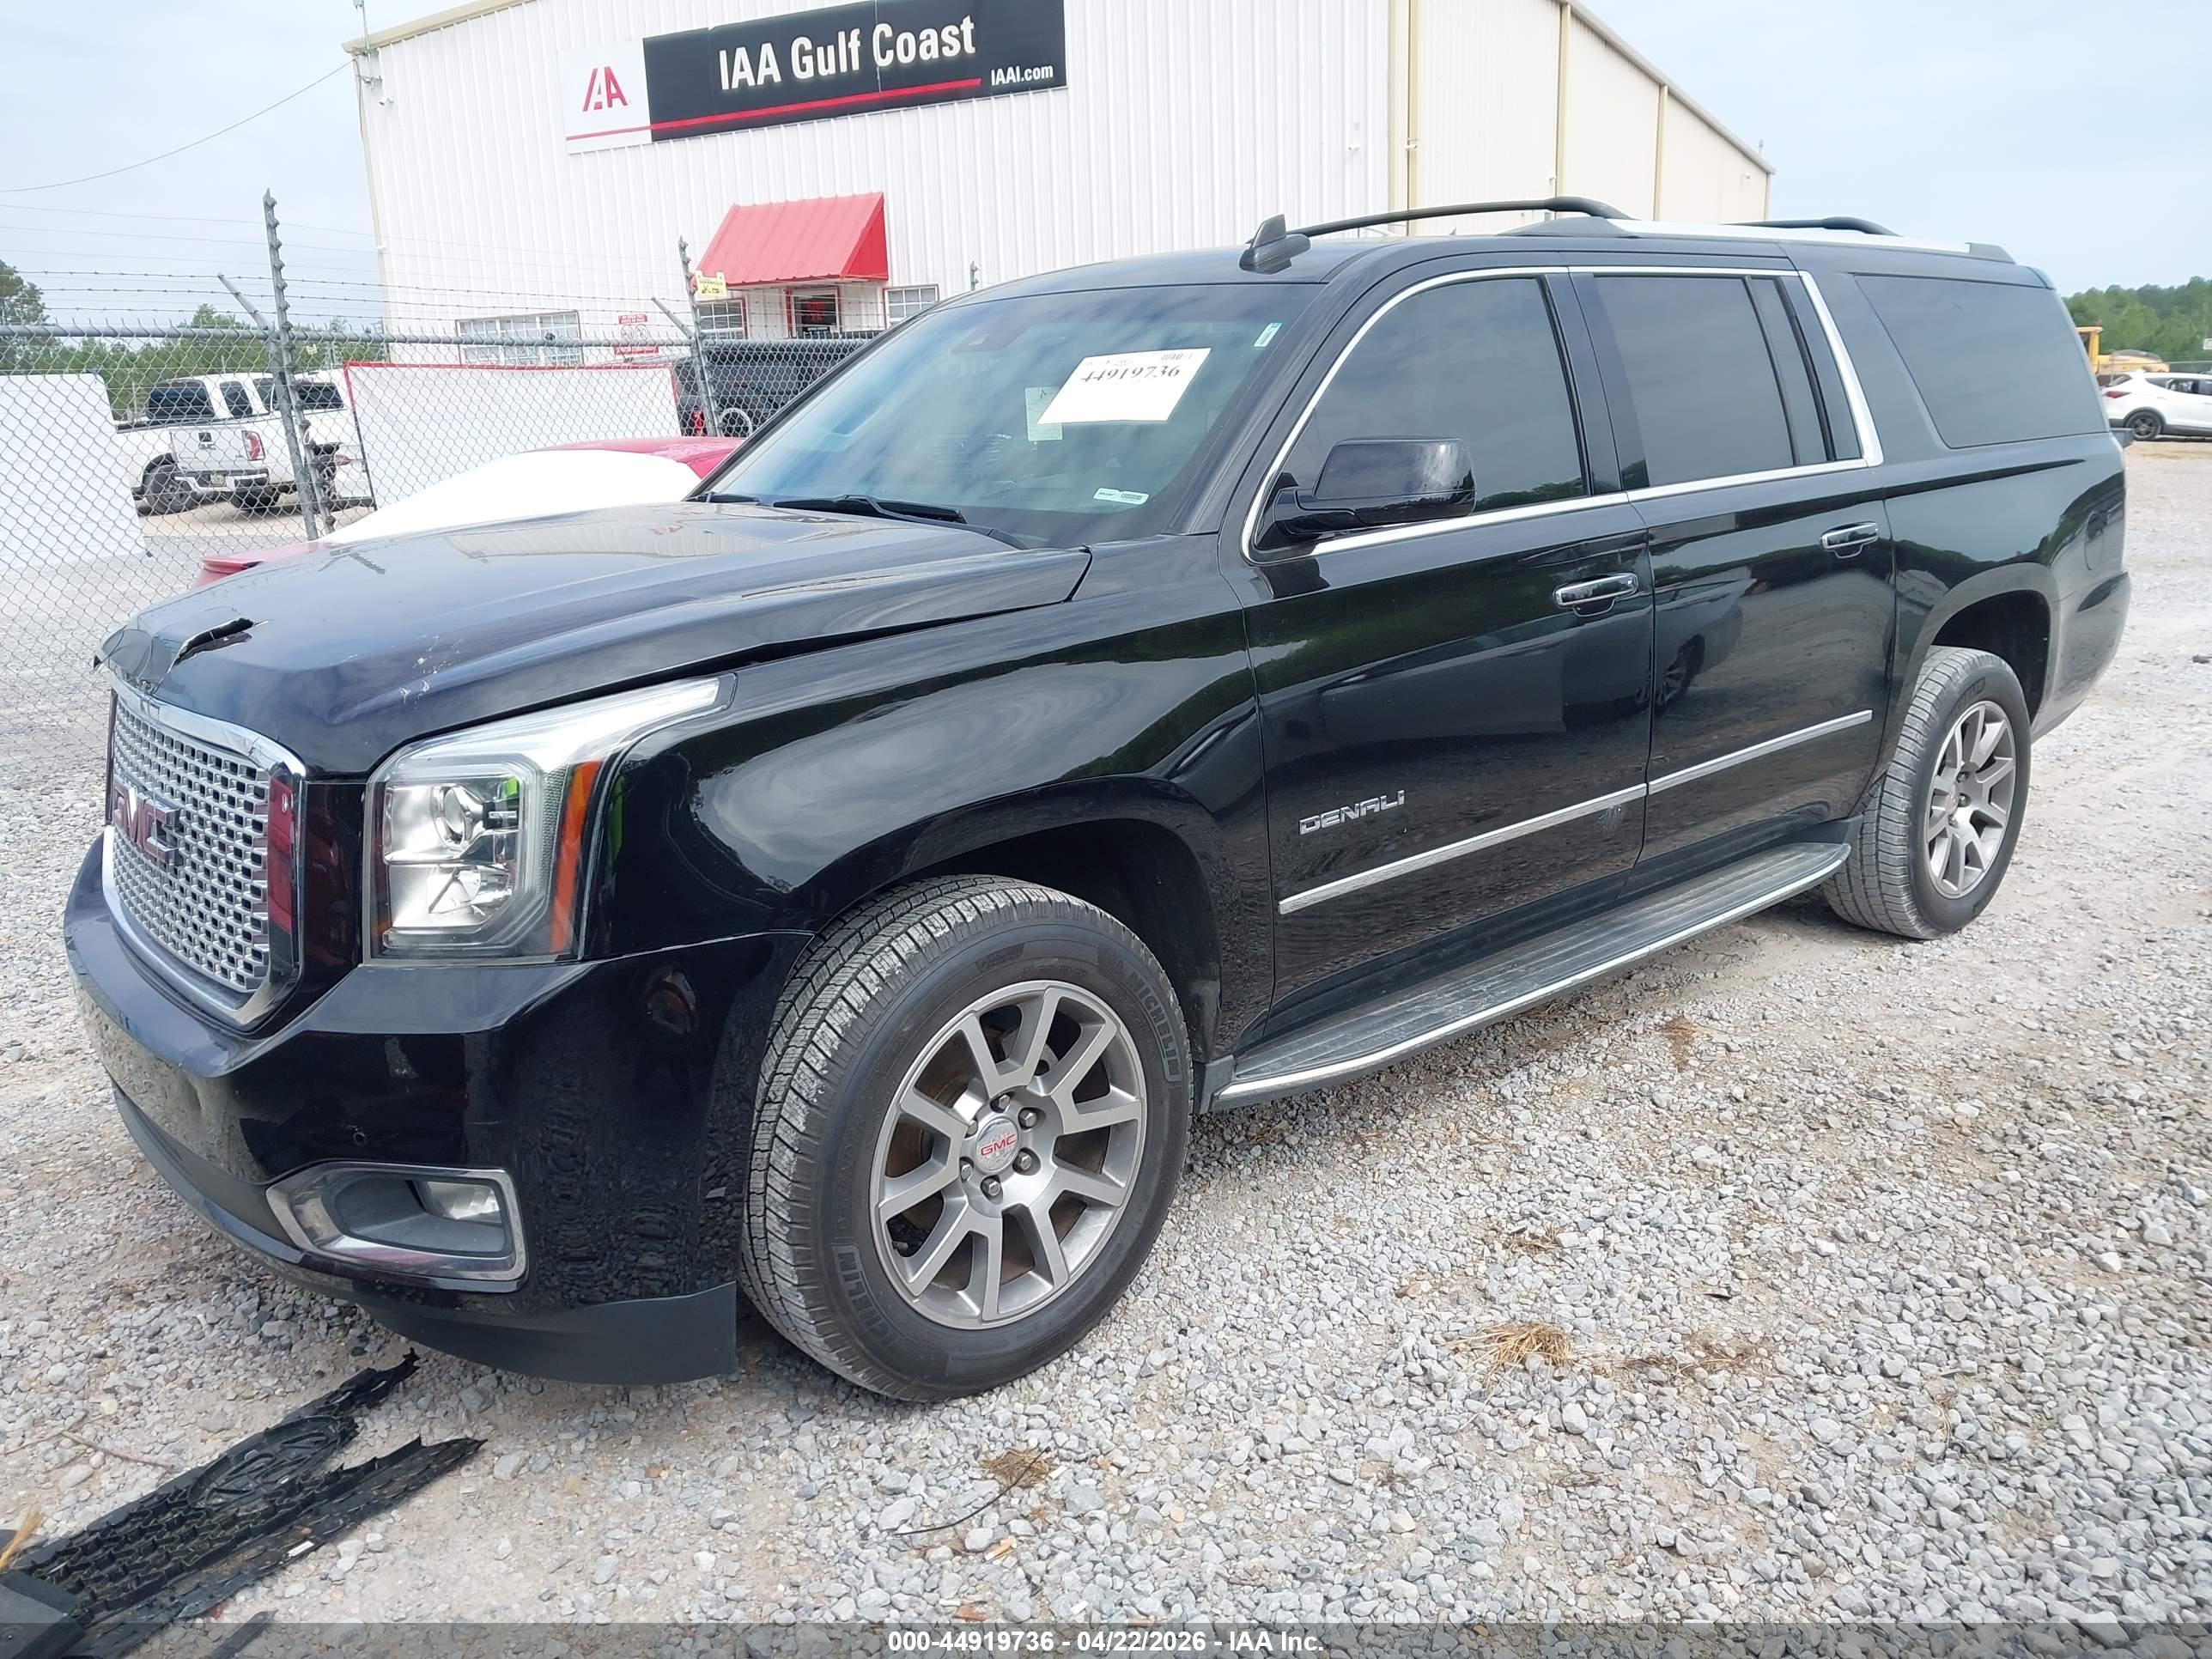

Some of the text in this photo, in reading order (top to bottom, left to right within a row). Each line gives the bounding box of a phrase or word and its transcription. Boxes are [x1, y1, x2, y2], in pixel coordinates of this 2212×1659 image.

[719, 15, 976, 90] IAA Gulf Coast
[991, 64, 1054, 86] IAAI.com
[1081, 364, 1181, 383] 44919736
[112, 780, 172, 866] GMC
[1299, 789, 1405, 836] DENALI
[1126, 970, 1180, 1076] MICHELIN
[981, 1133, 1017, 1156] GMC
